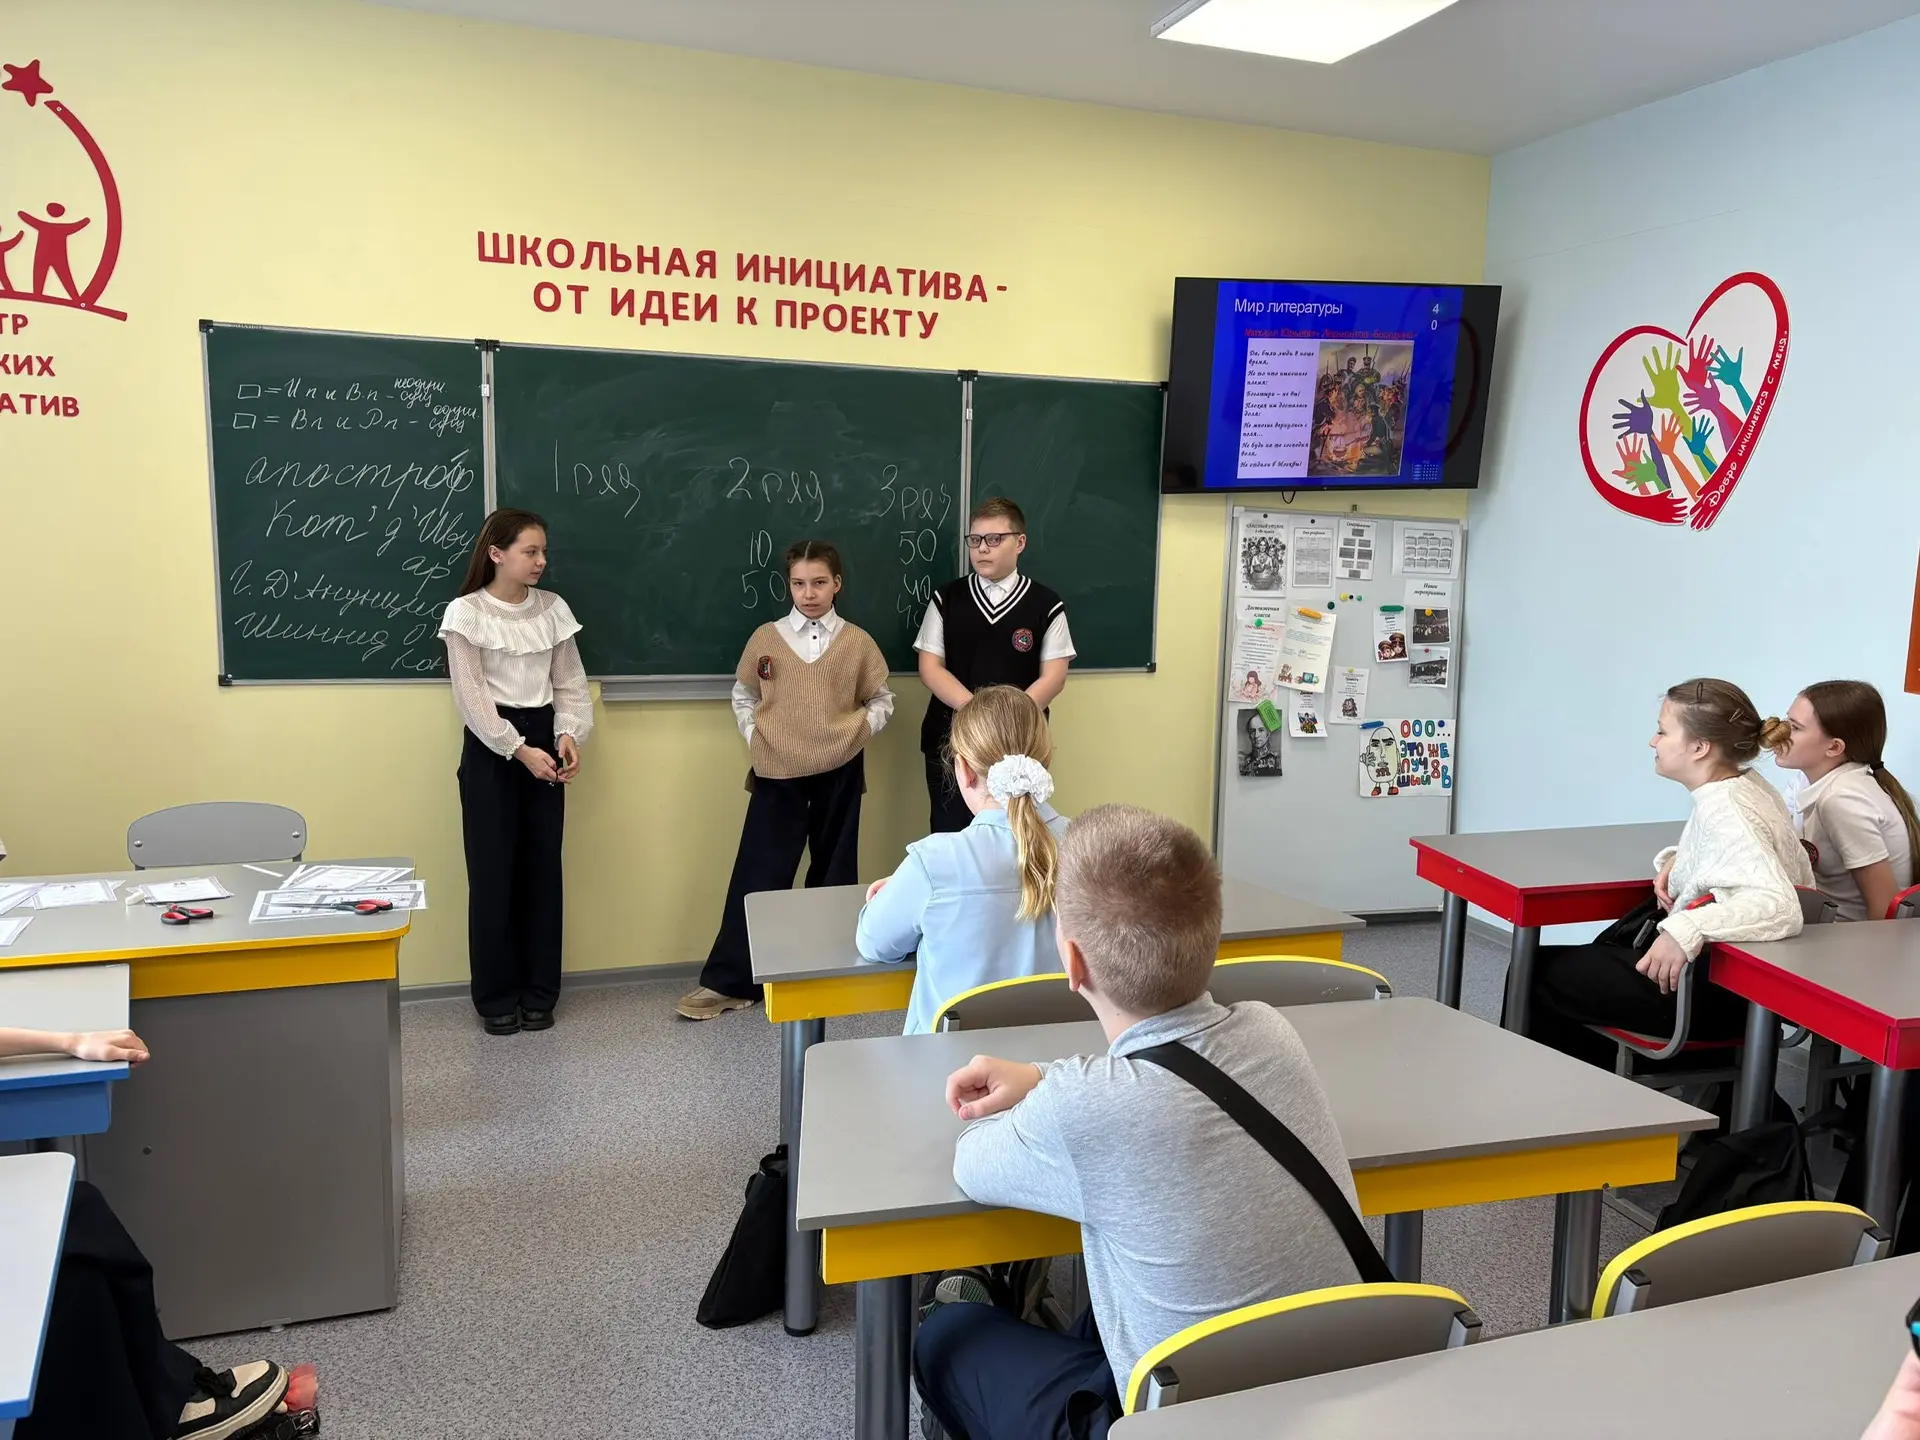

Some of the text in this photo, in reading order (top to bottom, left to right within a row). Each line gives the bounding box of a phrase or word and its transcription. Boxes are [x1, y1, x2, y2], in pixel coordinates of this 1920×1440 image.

[477, 230, 716, 279] ШКОЛЬНАЯ
[736, 252, 988, 303] ИНИЦИАТИВА
[533, 281, 939, 339] ОТ ИДЕИ К ПРОЕКТУ
[1234, 298, 1343, 317] Мир литературы
[1432, 303, 1439, 314] 4
[0, 393, 80, 417] АТИВ
[1702, 461, 1737, 508] Добро
[1737, 391, 1769, 457] начинается
[1767, 376, 1775, 385] с
[726, 456, 753, 499] 2
[878, 464, 897, 518] 3
[899, 528, 937, 566] 50
[741, 570, 787, 609] 50
[1400, 740, 1450, 759] ЭТО ЖЕ
[1431, 759, 1440, 779] 8
